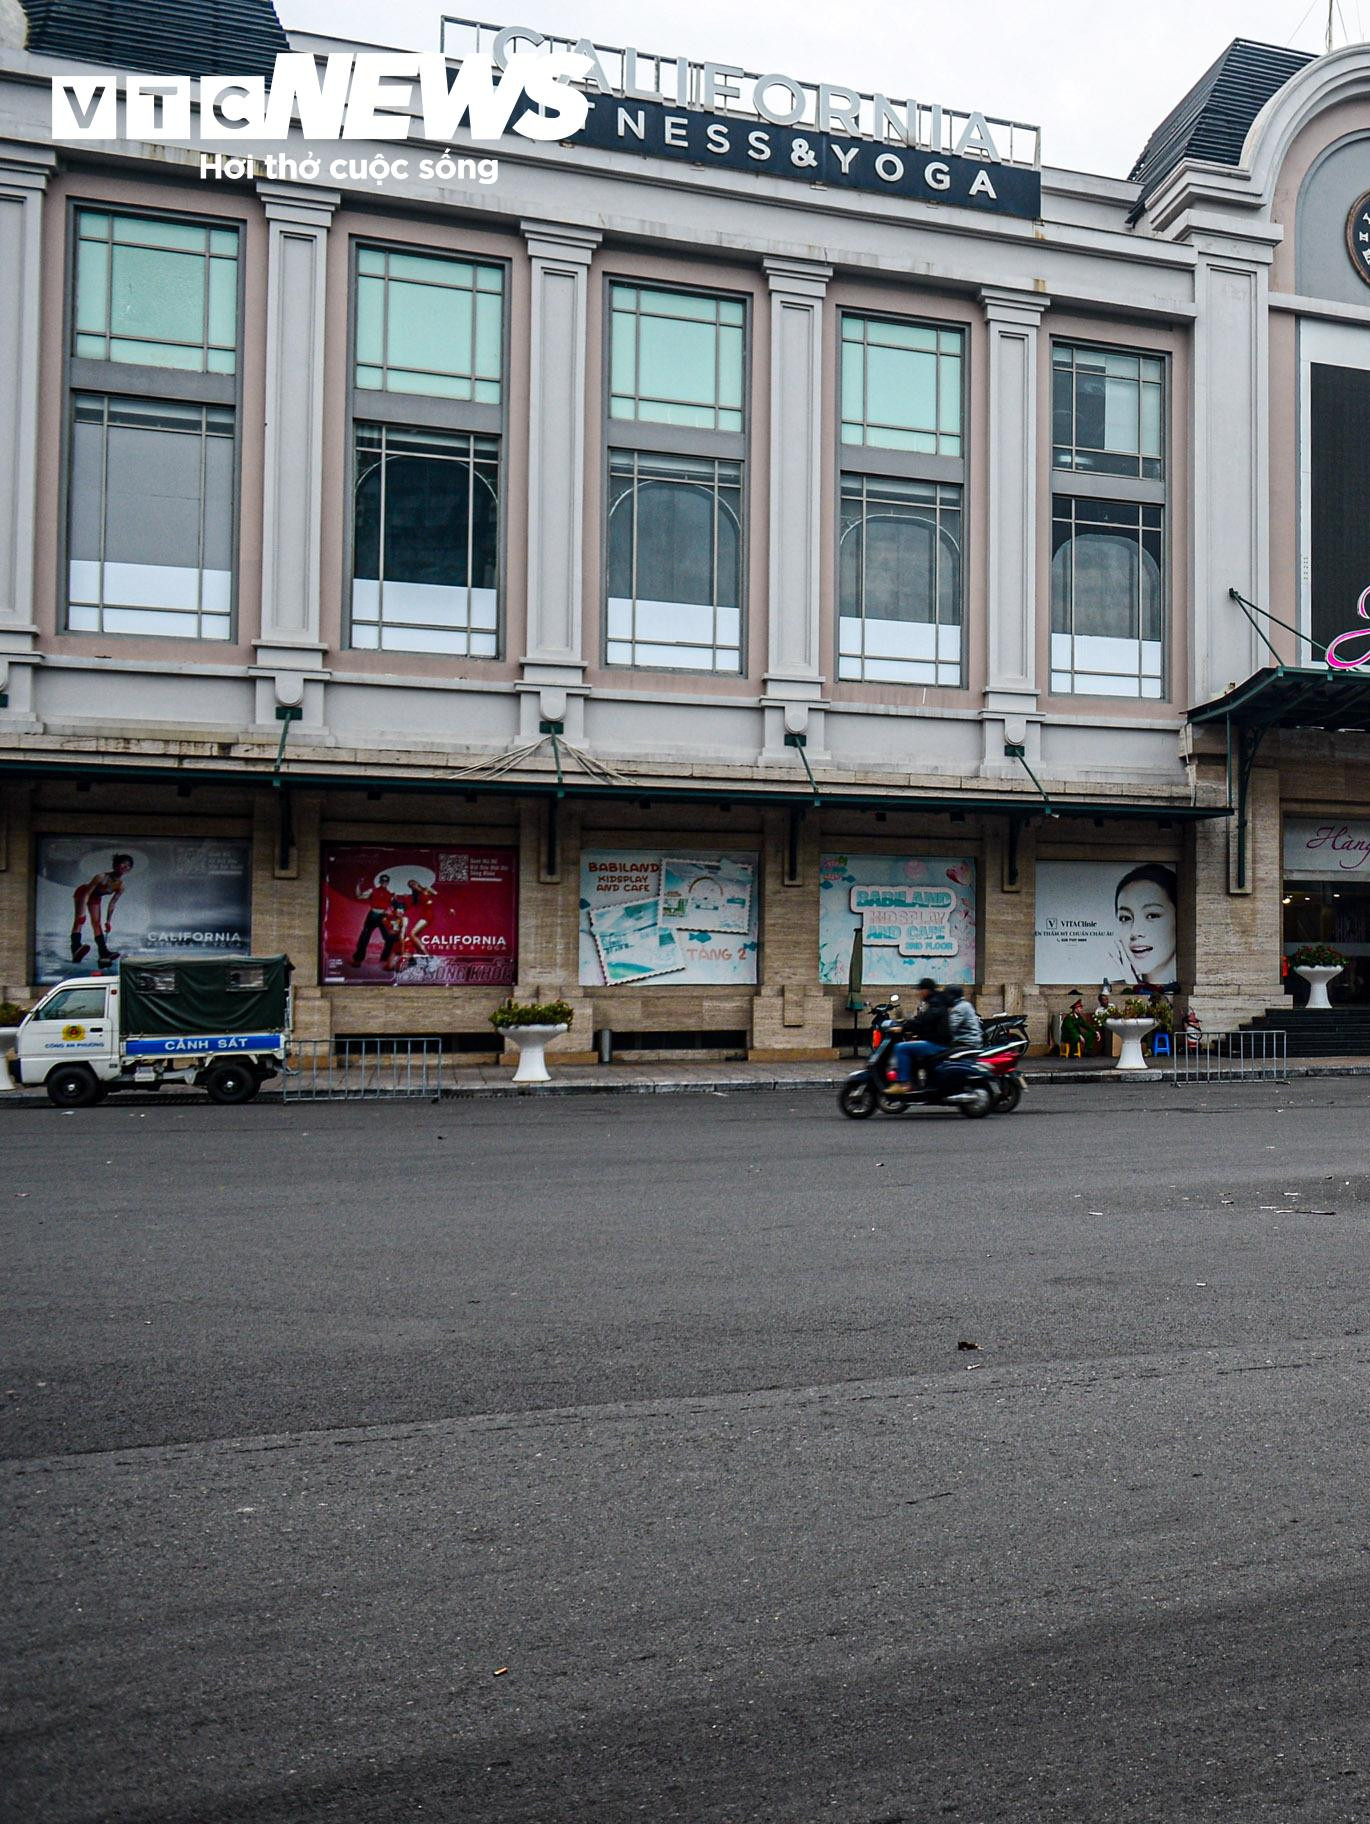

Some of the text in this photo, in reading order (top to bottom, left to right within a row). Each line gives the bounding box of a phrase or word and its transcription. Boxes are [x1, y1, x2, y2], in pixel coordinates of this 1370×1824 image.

[589, 862, 661, 873] BABILAND
[596, 884, 620, 892] AND
[147, 932, 241, 942] CALIFORNIA
[421, 935, 506, 945] CALIFORNIA
[738, 948, 747, 961] 2
[164, 1037, 248, 1050] CẢNH SÁT
